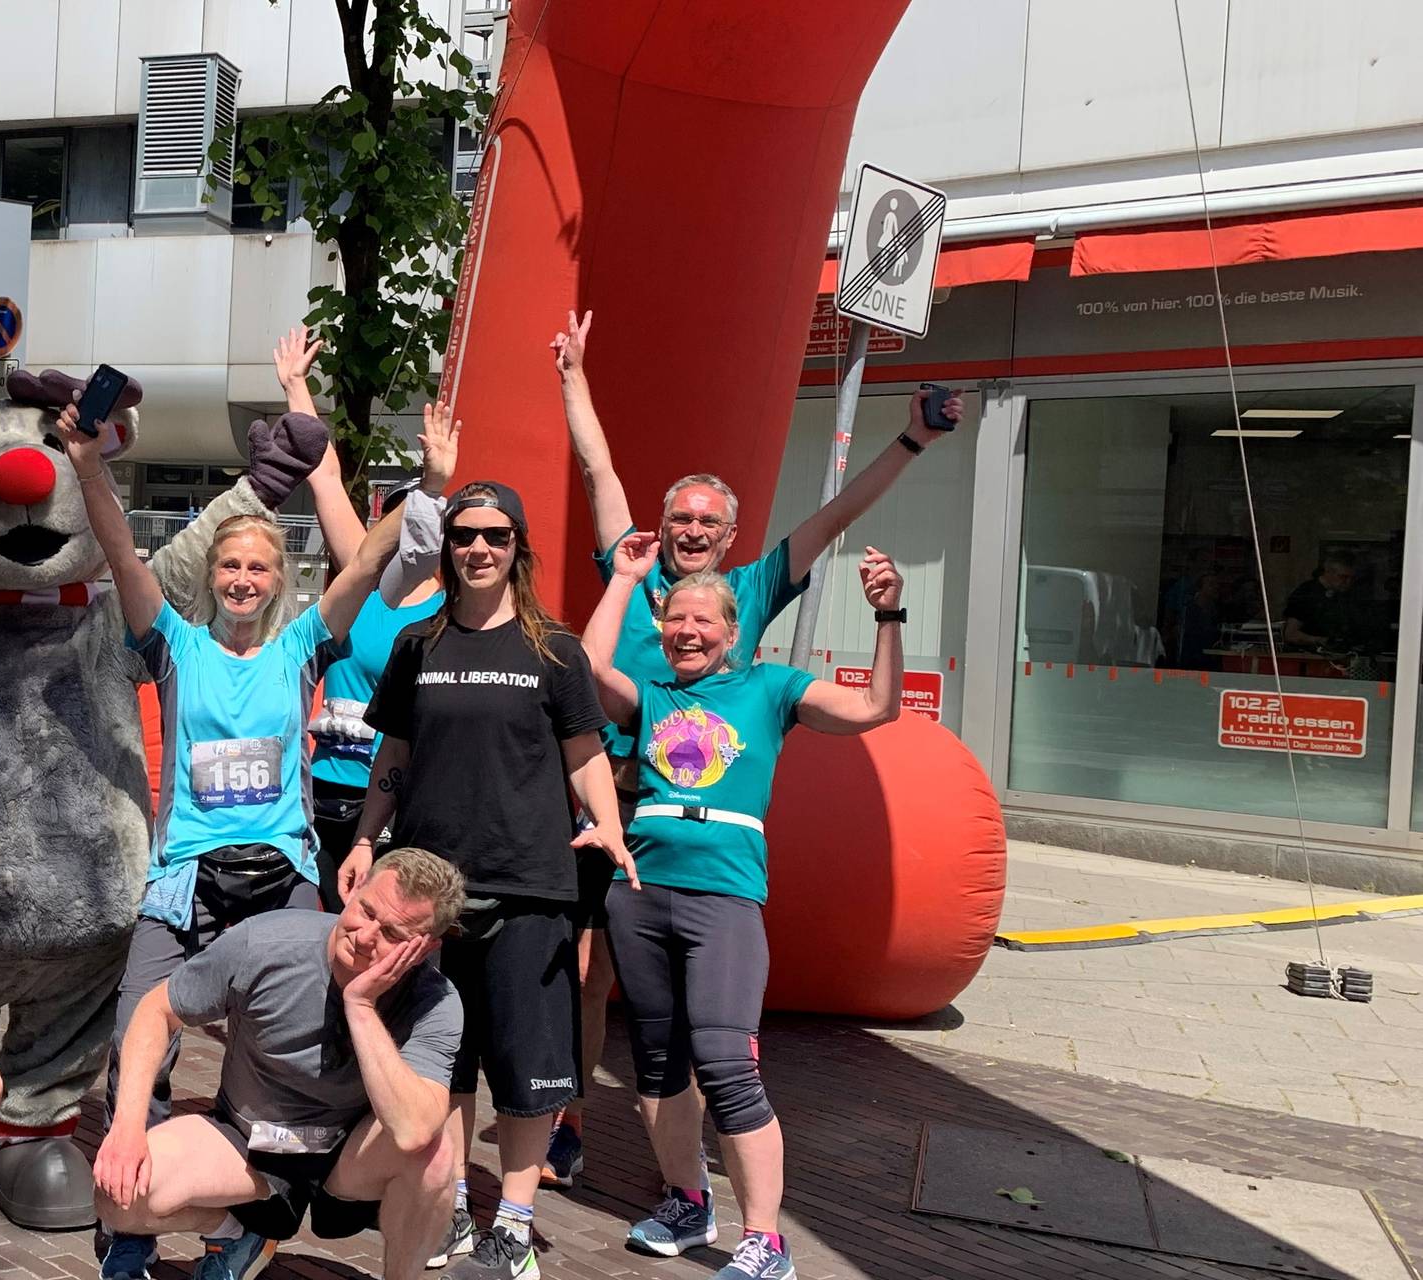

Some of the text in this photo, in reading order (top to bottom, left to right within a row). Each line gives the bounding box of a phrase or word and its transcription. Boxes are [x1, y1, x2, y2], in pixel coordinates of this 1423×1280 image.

[449, 324, 461, 360] die
[455, 252, 474, 320] beste
[861, 287, 907, 320] ZONE
[1076, 301, 1119, 316] 100%
[1123, 302, 1148, 313] von
[1151, 298, 1182, 311] hier.
[1234, 292, 1258, 305] die
[1260, 289, 1306, 304] beste
[1310, 284, 1364, 301] Musik.
[811, 318, 844, 331] adio
[6, 363, 16, 375] Fr
[414, 670, 540, 689] ANIMAL LIBERATION
[839, 670, 873, 684] 102.
[902, 689, 934, 700] ssen
[1228, 695, 1281, 712] 102.2
[652, 709, 684, 735] 2019
[1237, 711, 1355, 730] radio essen
[1256, 737, 1271, 746] von
[1292, 741, 1309, 749] Der
[209, 759, 270, 792] 156
[530, 1076, 574, 1091] SPALDING
